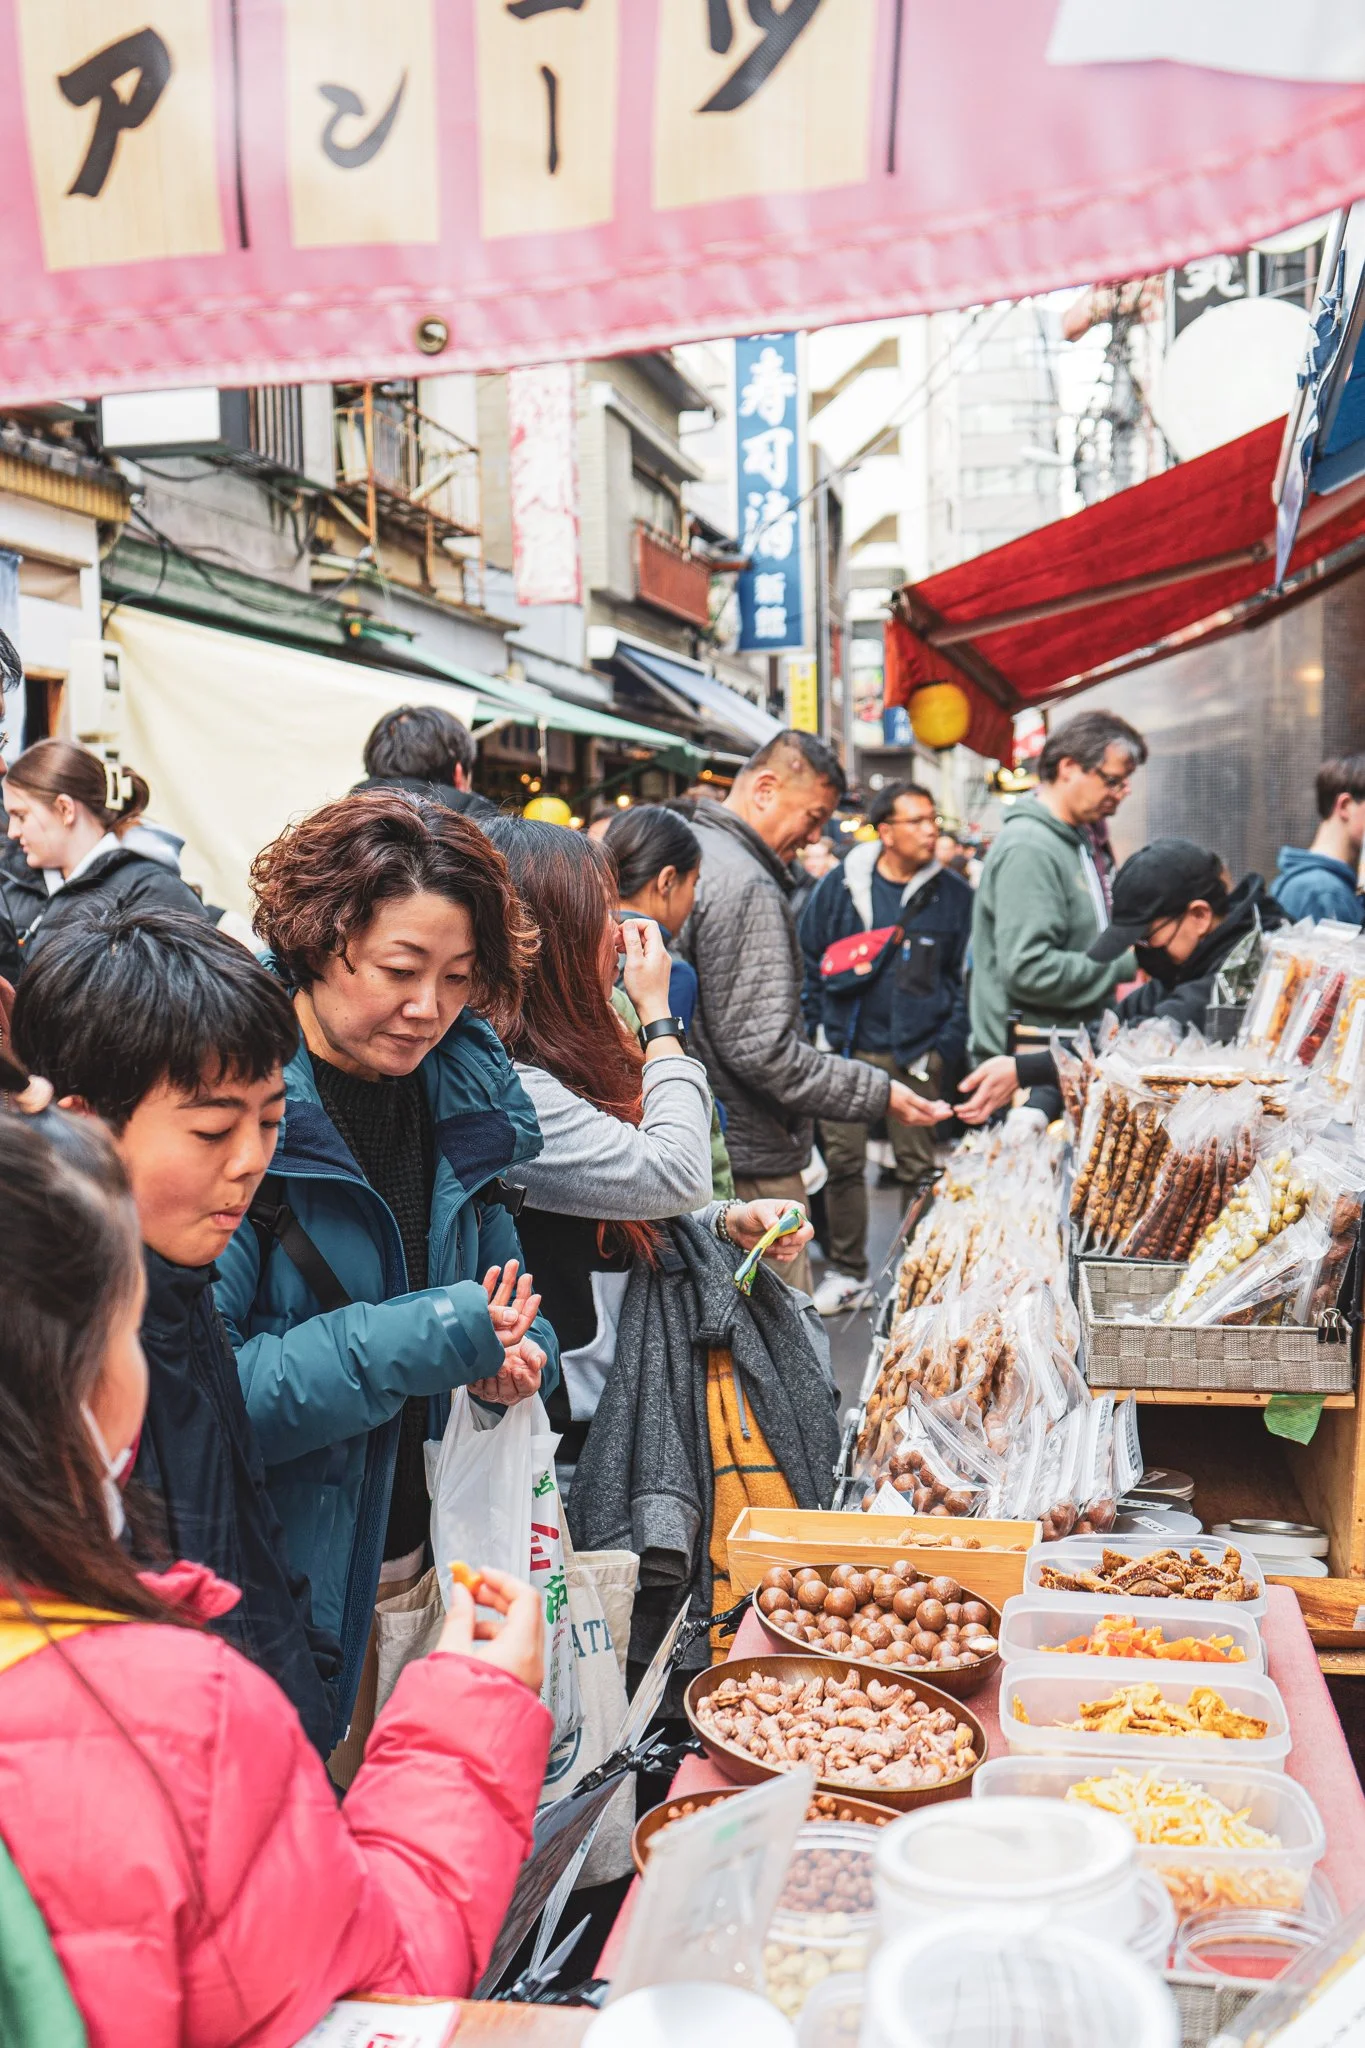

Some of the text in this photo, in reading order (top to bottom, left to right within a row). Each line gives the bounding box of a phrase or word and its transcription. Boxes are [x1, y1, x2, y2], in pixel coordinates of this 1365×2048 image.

[57, 26, 172, 198] ア
[317, 68, 408, 169] ン
[739, 333, 798, 560] 寿司清
